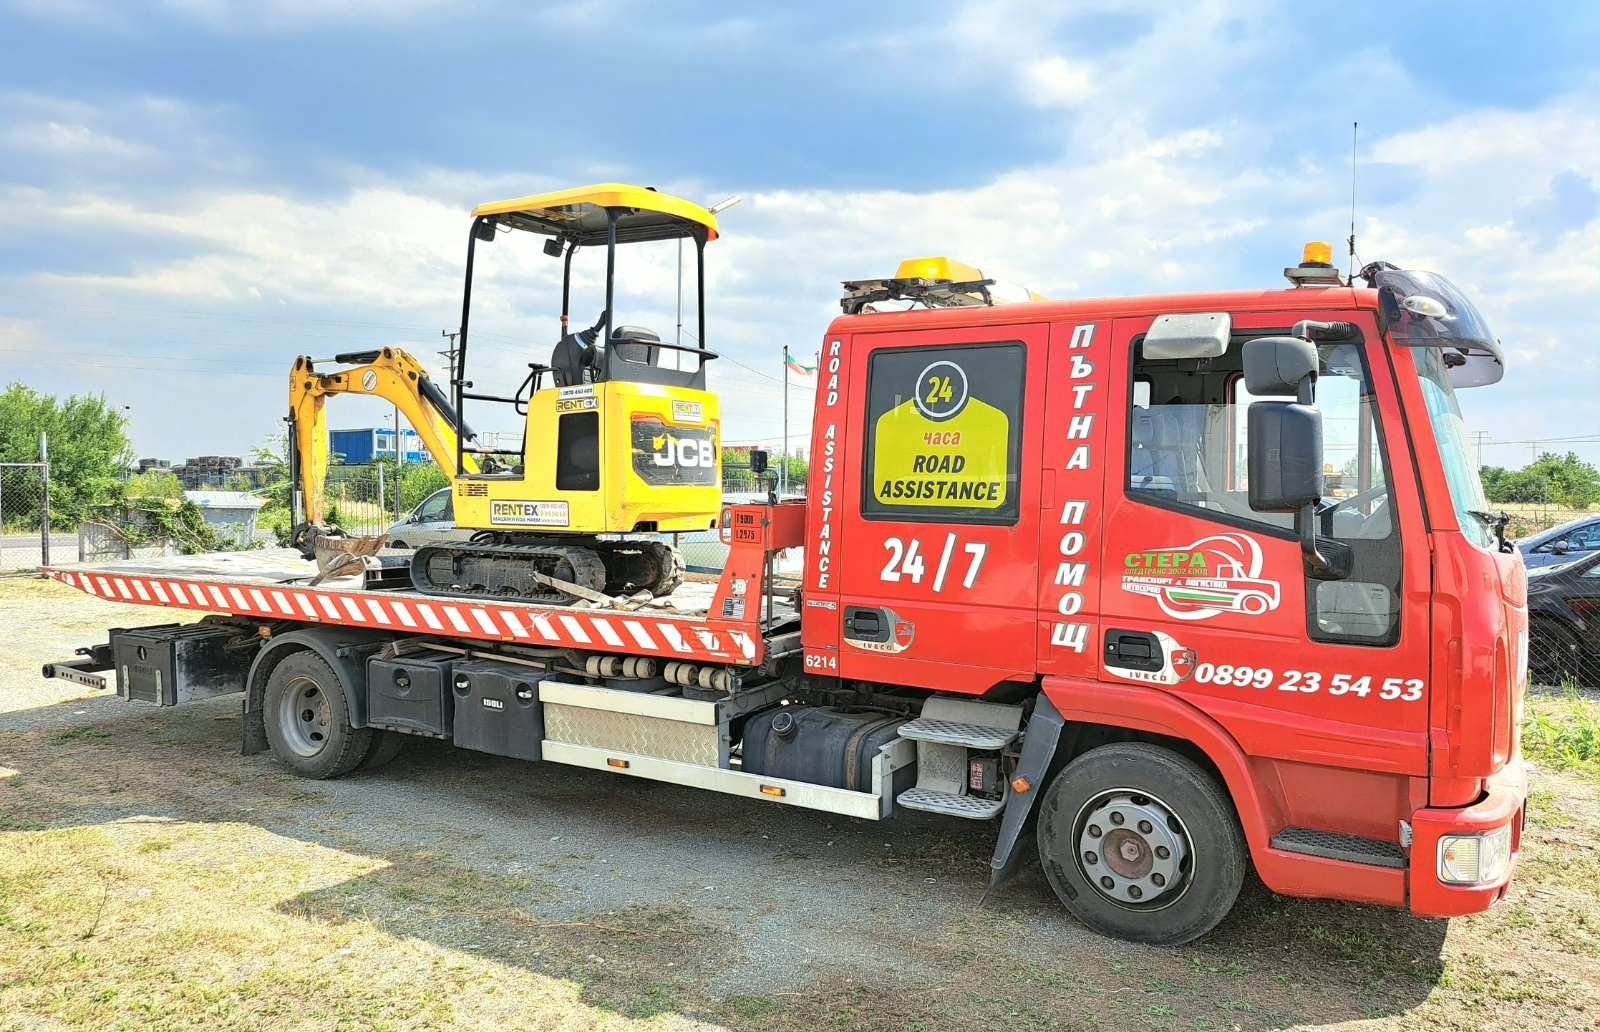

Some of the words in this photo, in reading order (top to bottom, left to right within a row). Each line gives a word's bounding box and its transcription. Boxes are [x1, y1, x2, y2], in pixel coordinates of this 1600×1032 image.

[826, 341, 841, 407] ROAD
[926, 376, 953, 403] 24
[1066, 323, 1097, 470] ПЪТНА
[923, 431, 961, 446] часа
[653, 438, 713, 467] JCB
[913, 455, 966, 473] ROAD
[880, 480, 1001, 501] ASSISTANCE
[493, 503, 538, 516] RENTEX
[818, 424, 836, 589] ASSISTANCE
[1124, 552, 1208, 568] СТЕРА
[1050, 500, 1090, 653] ПОМОЩ
[863, 643, 892, 651] IVECO
[805, 655, 837, 669] 6214
[1129, 671, 1168, 682] IVECO
[1194, 663, 1274, 689] 0899
[1278, 670, 1323, 693] 23
[1328, 674, 1372, 698] 54
[1378, 678, 1425, 702] 53
